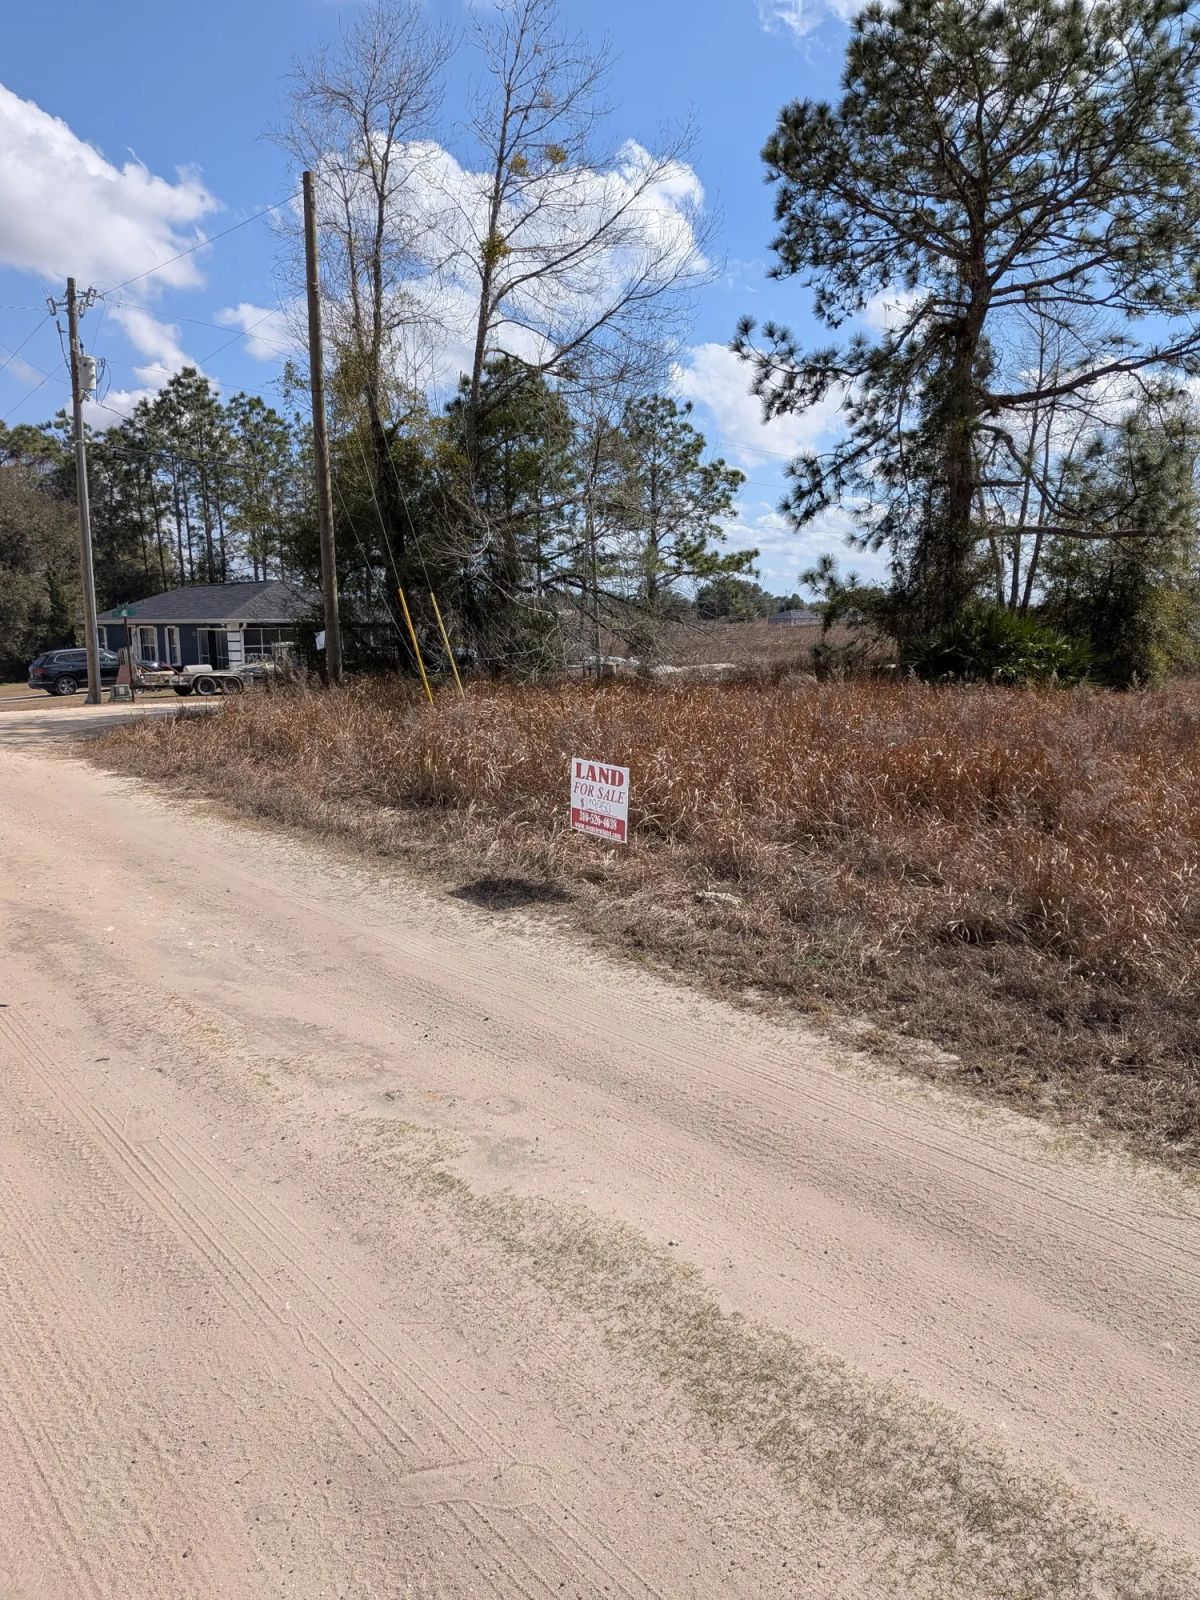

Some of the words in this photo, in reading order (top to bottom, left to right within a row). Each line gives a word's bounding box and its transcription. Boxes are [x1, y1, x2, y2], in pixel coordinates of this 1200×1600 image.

[575, 762, 624, 787] LAND
[574, 782, 595, 797] FOR
[597, 786, 625, 804] SALE
